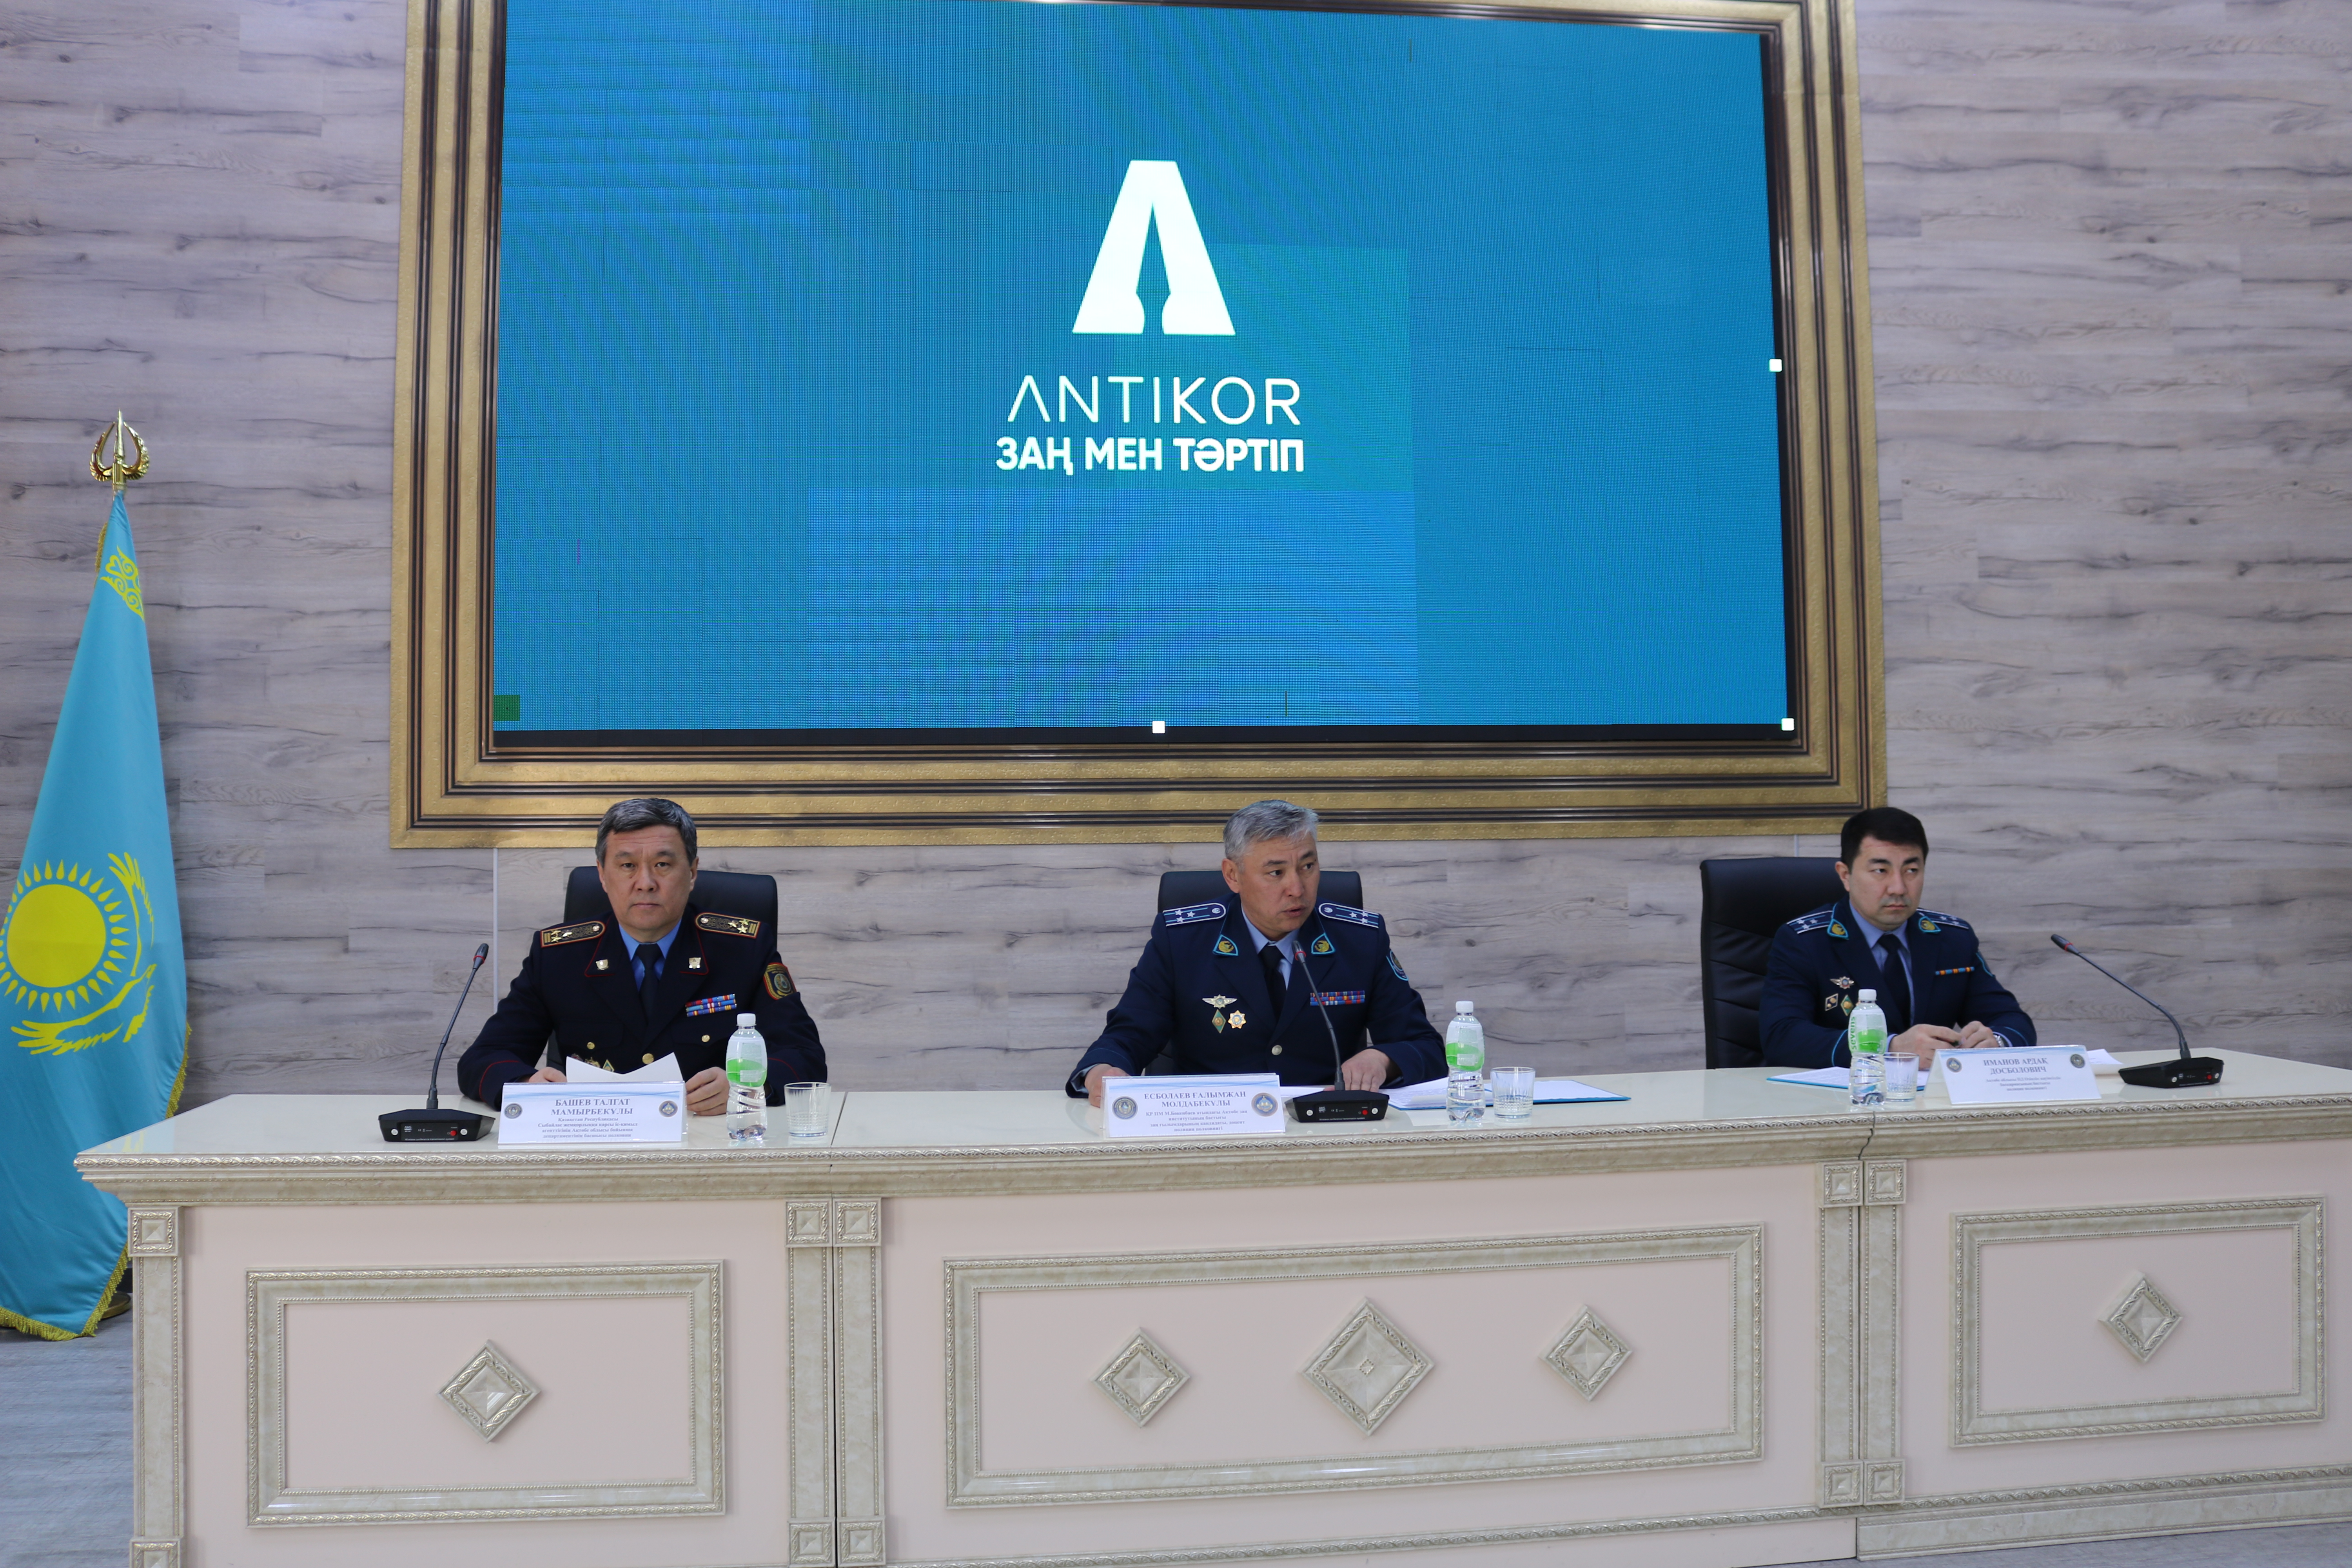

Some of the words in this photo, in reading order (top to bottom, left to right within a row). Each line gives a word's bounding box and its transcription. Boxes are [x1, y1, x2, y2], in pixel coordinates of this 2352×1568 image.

[1007, 375, 1301, 425] ANTIKOR
[995, 435, 1074, 475] ЗАҢ
[1085, 436, 1162, 471] МЕН
[1172, 437, 1304, 473] ТӘРТІП
[1990, 1066, 2047, 1074] ДОСБОЛОВИЧ
